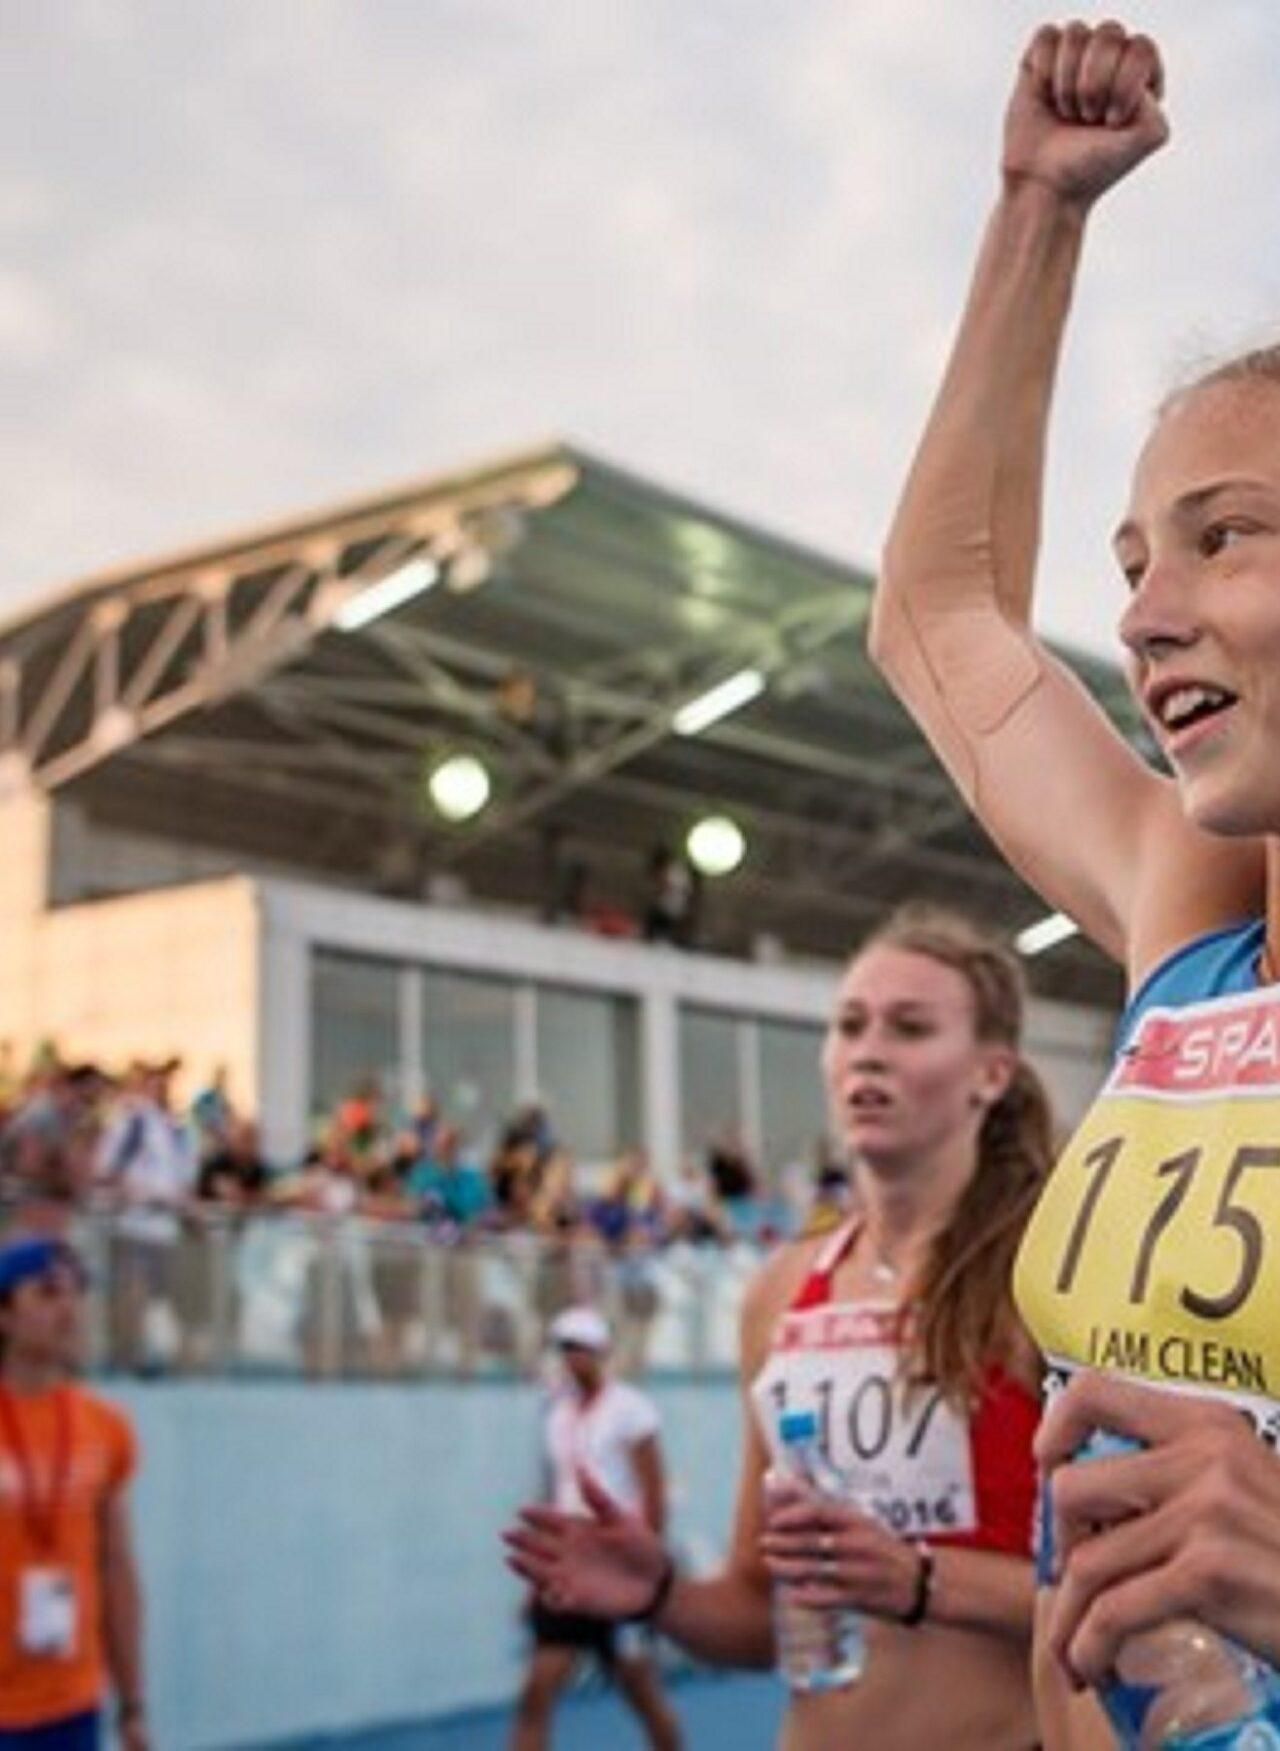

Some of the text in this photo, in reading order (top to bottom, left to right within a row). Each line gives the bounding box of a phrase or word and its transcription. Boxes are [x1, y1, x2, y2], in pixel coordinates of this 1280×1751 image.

[1089, 1328, 1268, 1391] I AM CLEAN
